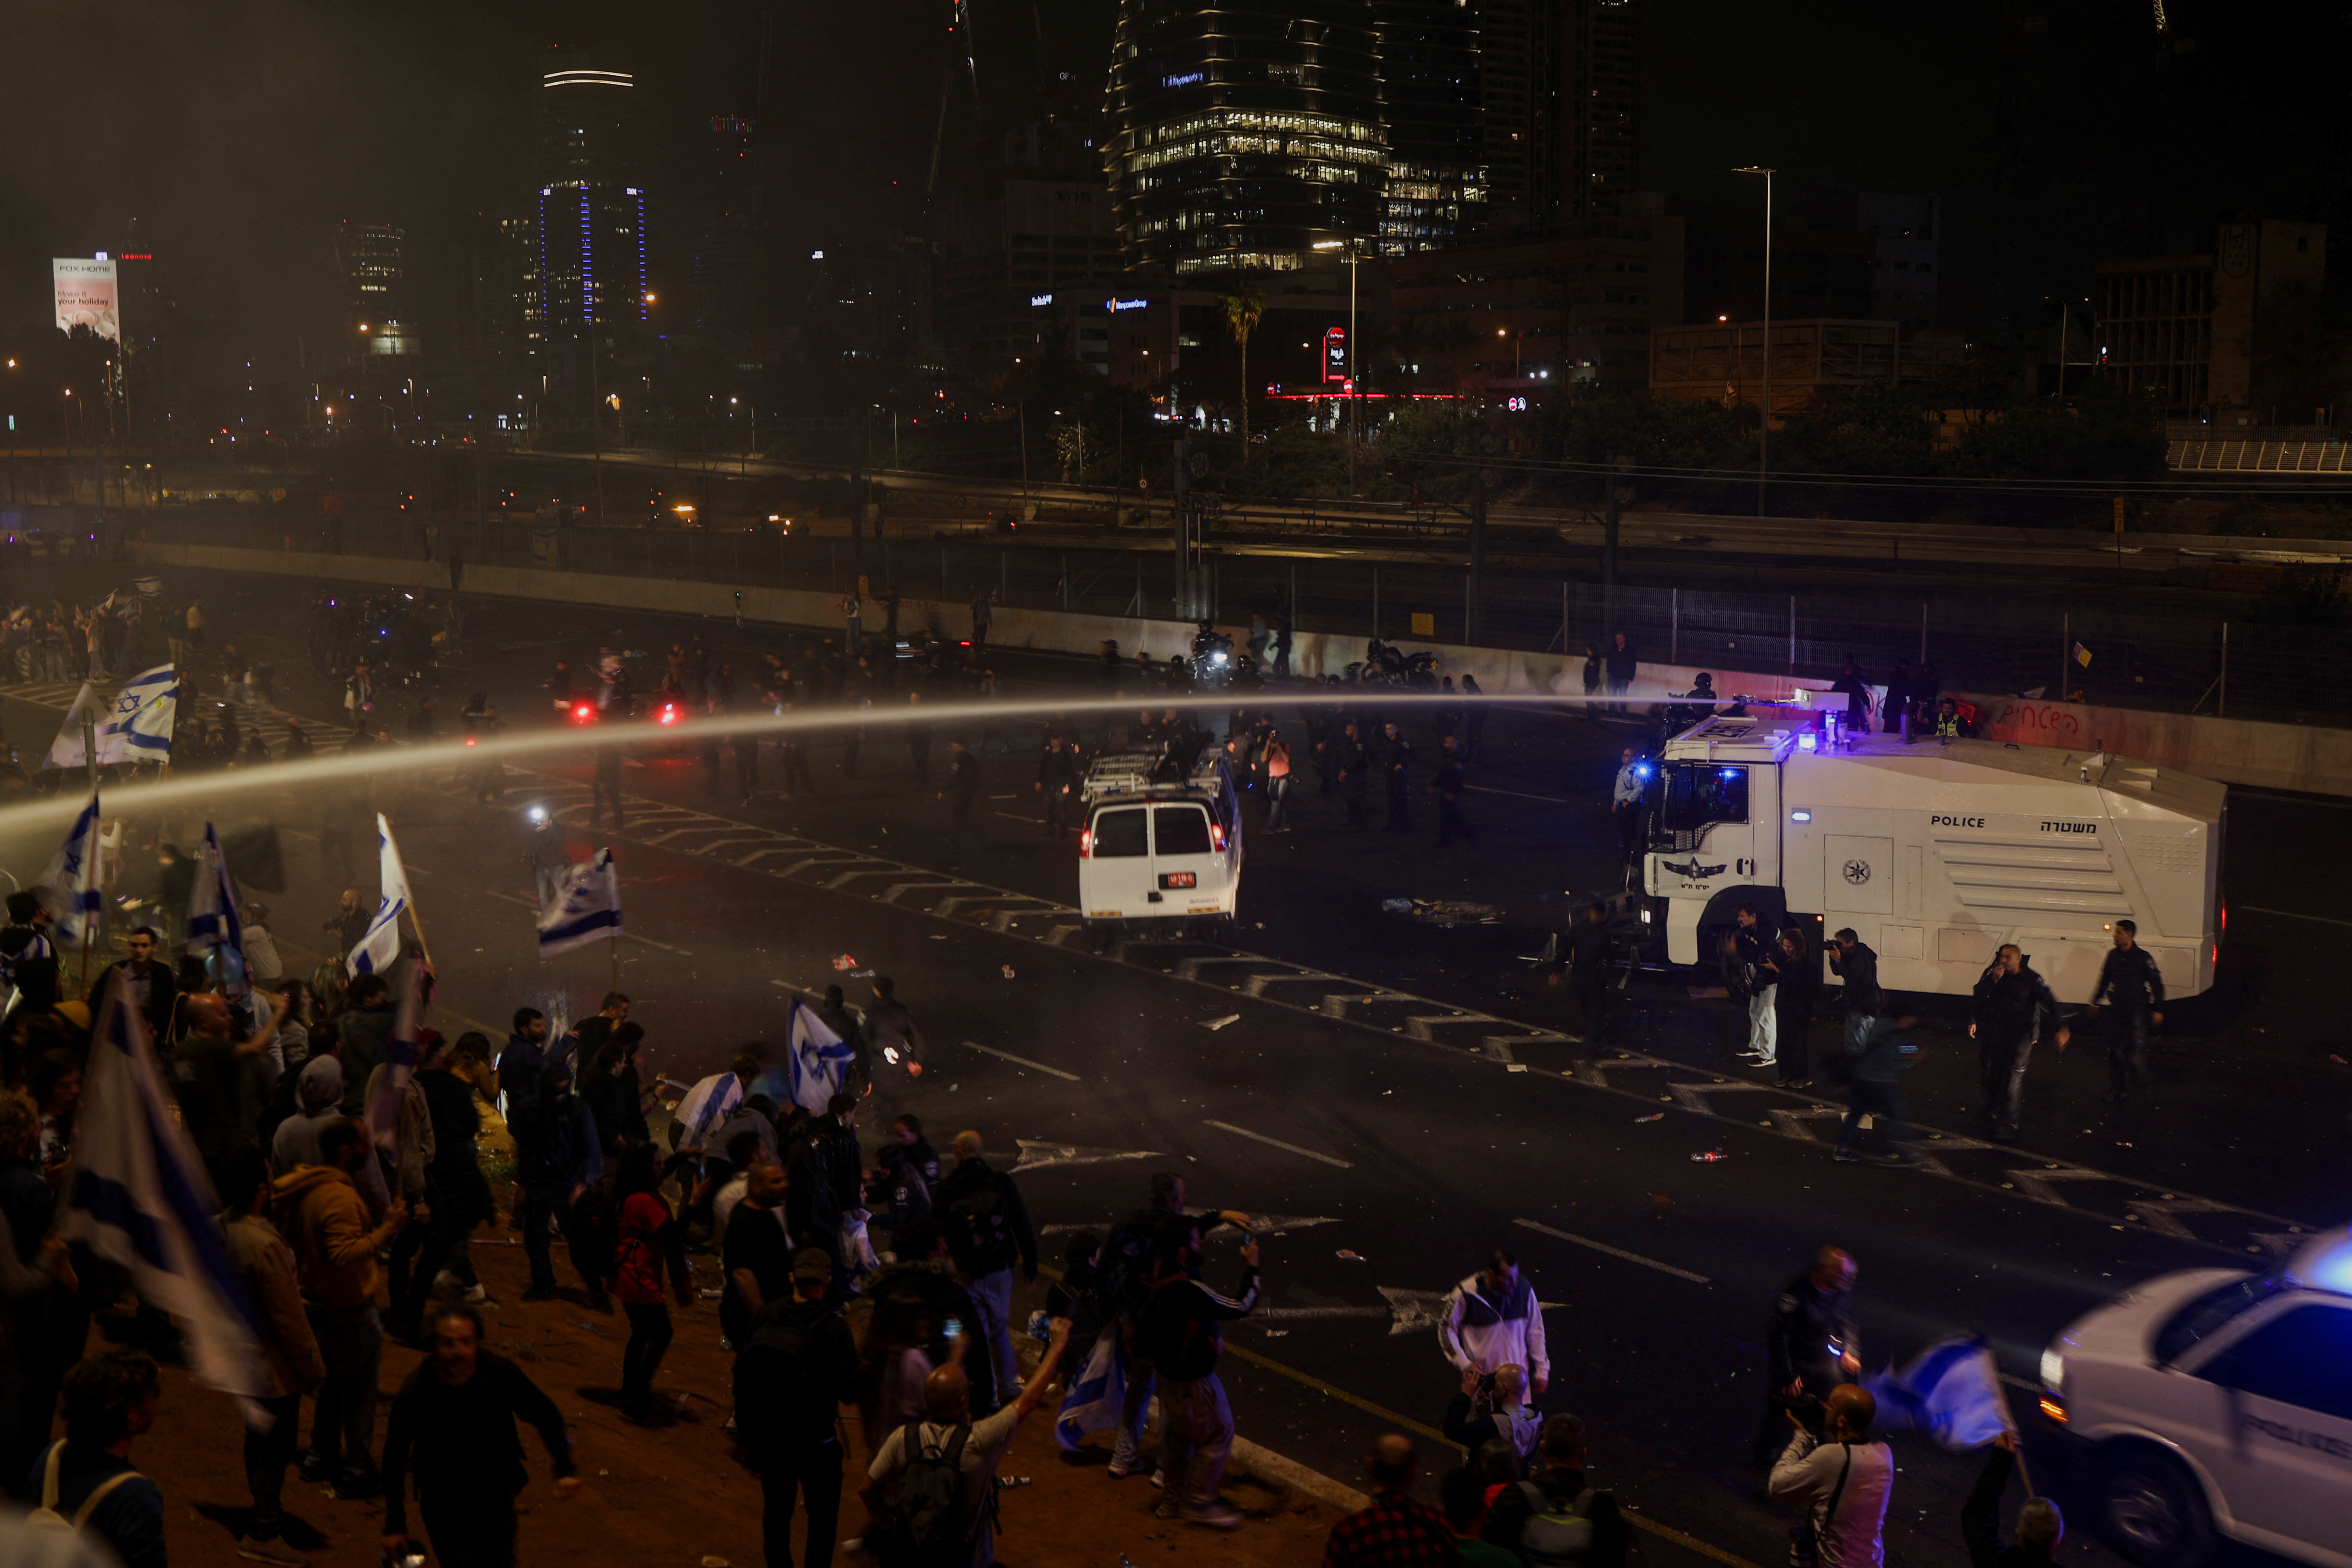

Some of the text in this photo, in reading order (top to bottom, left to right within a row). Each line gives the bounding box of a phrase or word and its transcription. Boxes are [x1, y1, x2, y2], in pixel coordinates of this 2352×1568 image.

[626, 187, 637, 195] IBM
[57, 290, 80, 298] Make
[79, 298, 109, 307] holiday
[1931, 816, 1985, 828] POLICE
[2041, 821, 2097, 834] משטרה
